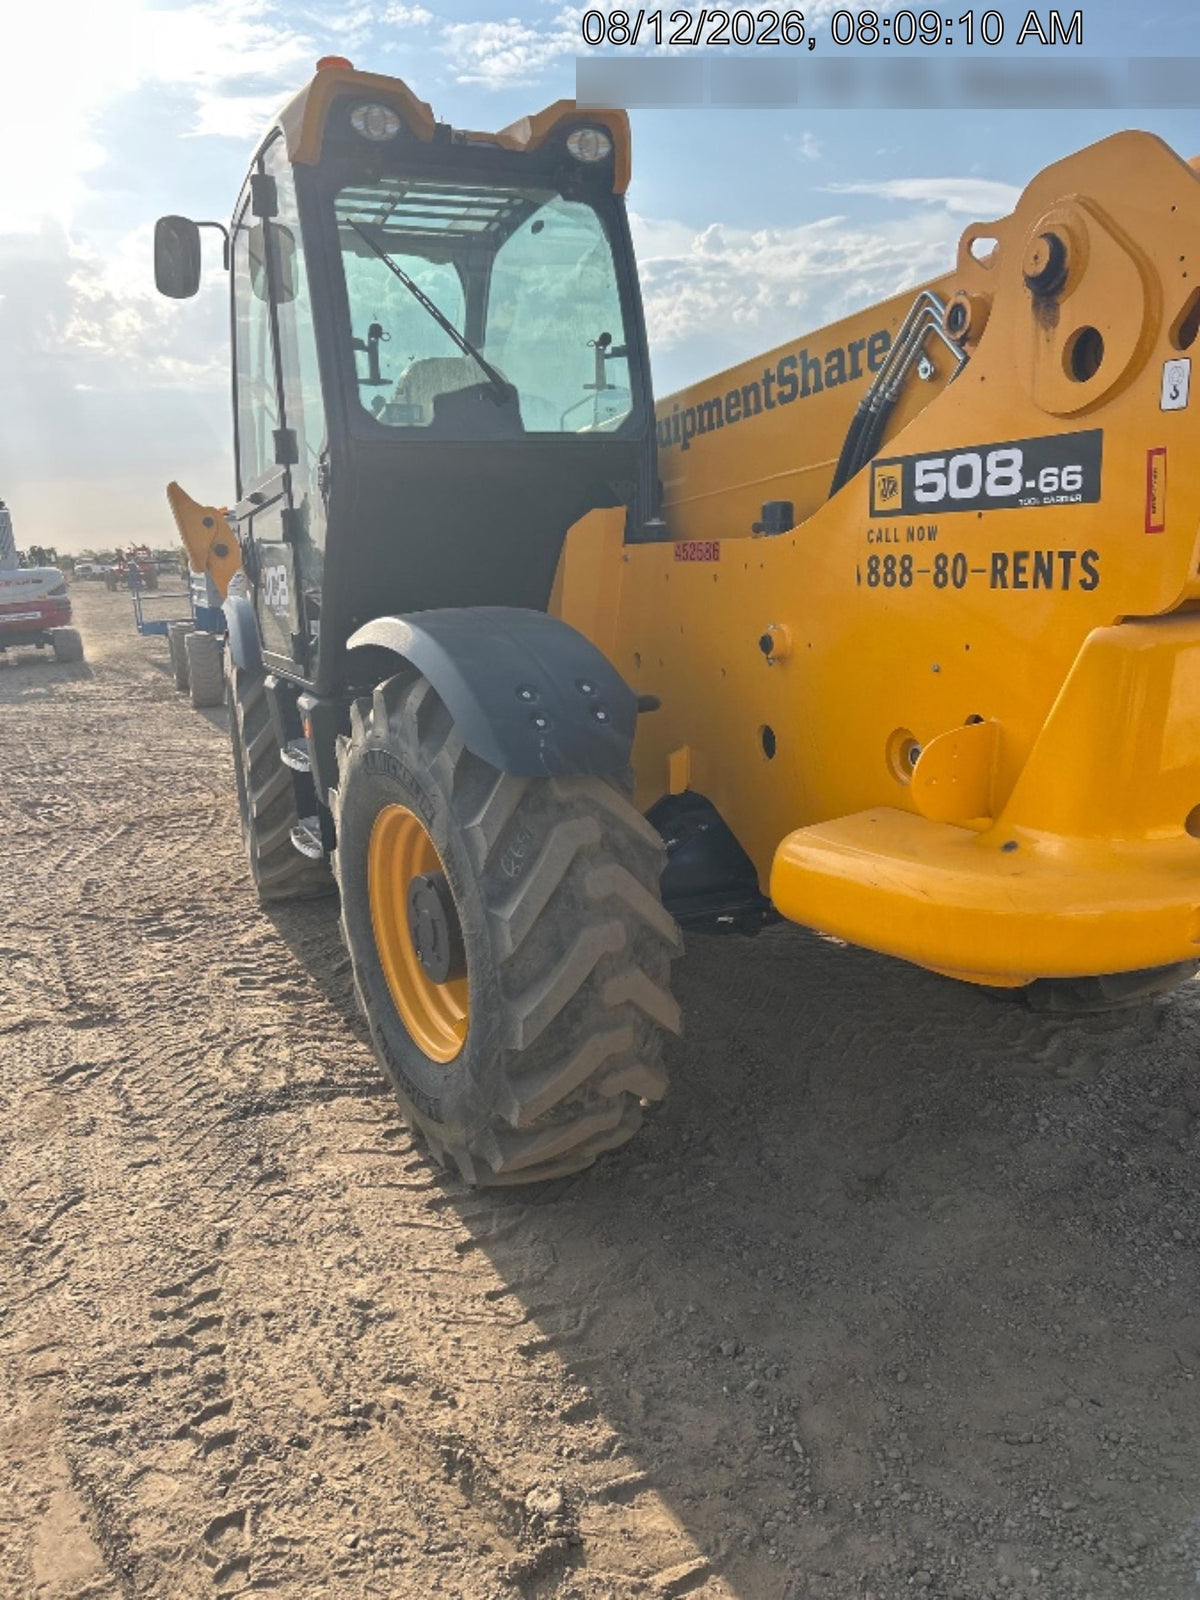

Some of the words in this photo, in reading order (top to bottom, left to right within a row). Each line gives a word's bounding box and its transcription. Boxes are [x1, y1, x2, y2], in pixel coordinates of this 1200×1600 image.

[655, 328, 891, 452] uipmentShare
[867, 527, 900, 543] CALL
[907, 525, 938, 542] NOW
